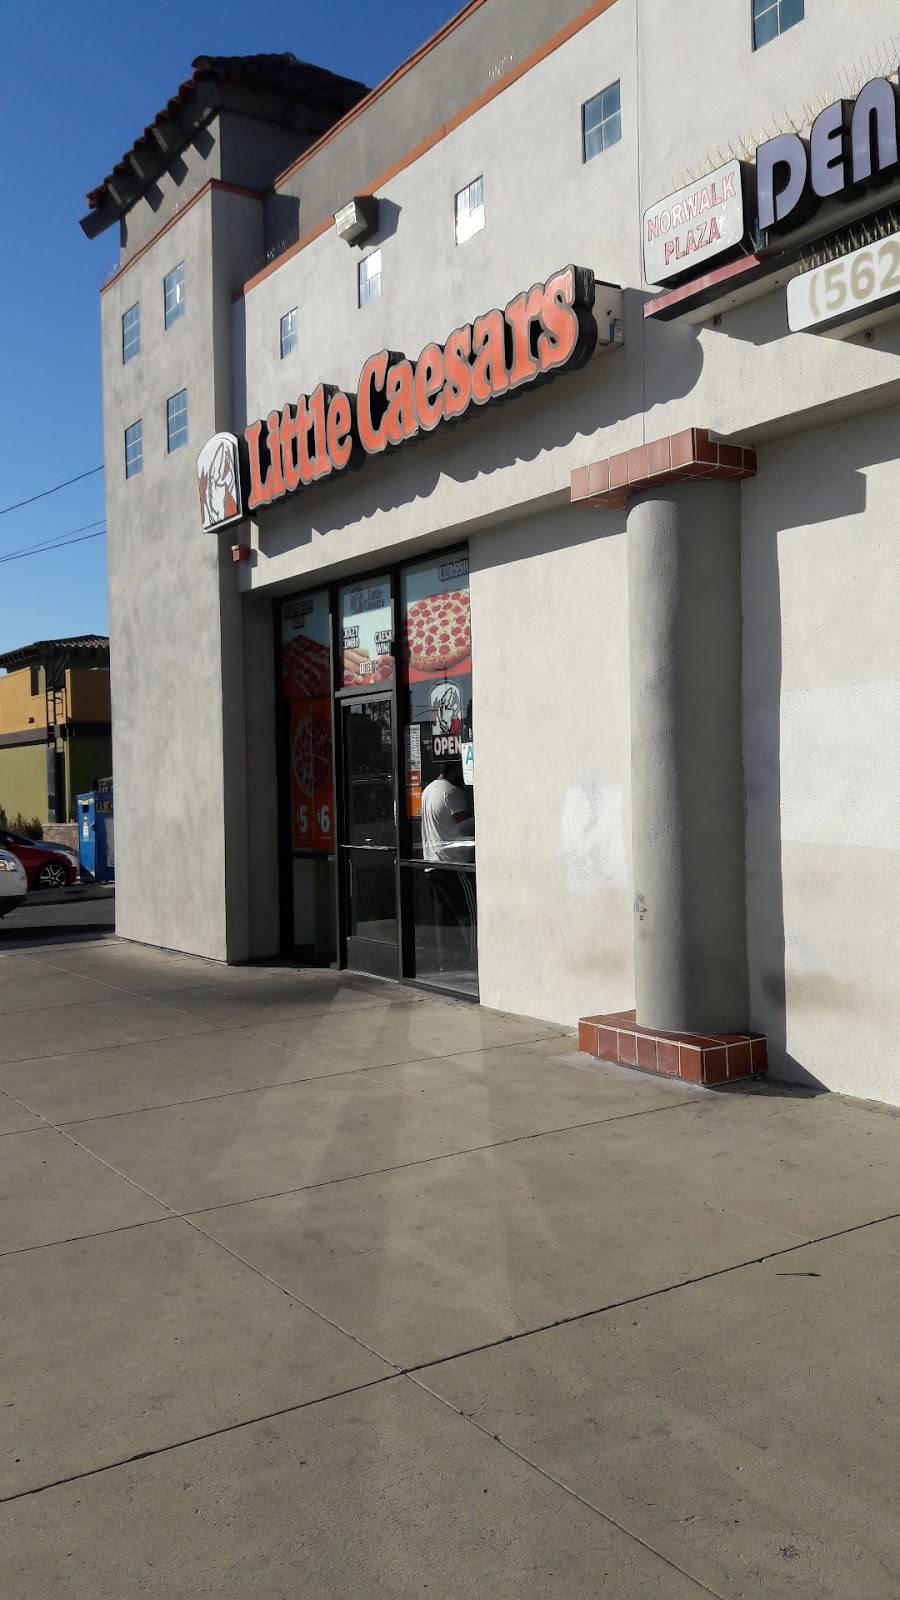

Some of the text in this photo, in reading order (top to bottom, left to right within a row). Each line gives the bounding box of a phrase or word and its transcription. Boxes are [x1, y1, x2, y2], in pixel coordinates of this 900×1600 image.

[647, 170, 737, 242] NORWALK
[663, 216, 722, 266] PLAZA
[245, 264, 580, 510] Little Caesars
[433, 735, 462, 756] OPEN
[465, 745, 474, 766] A
